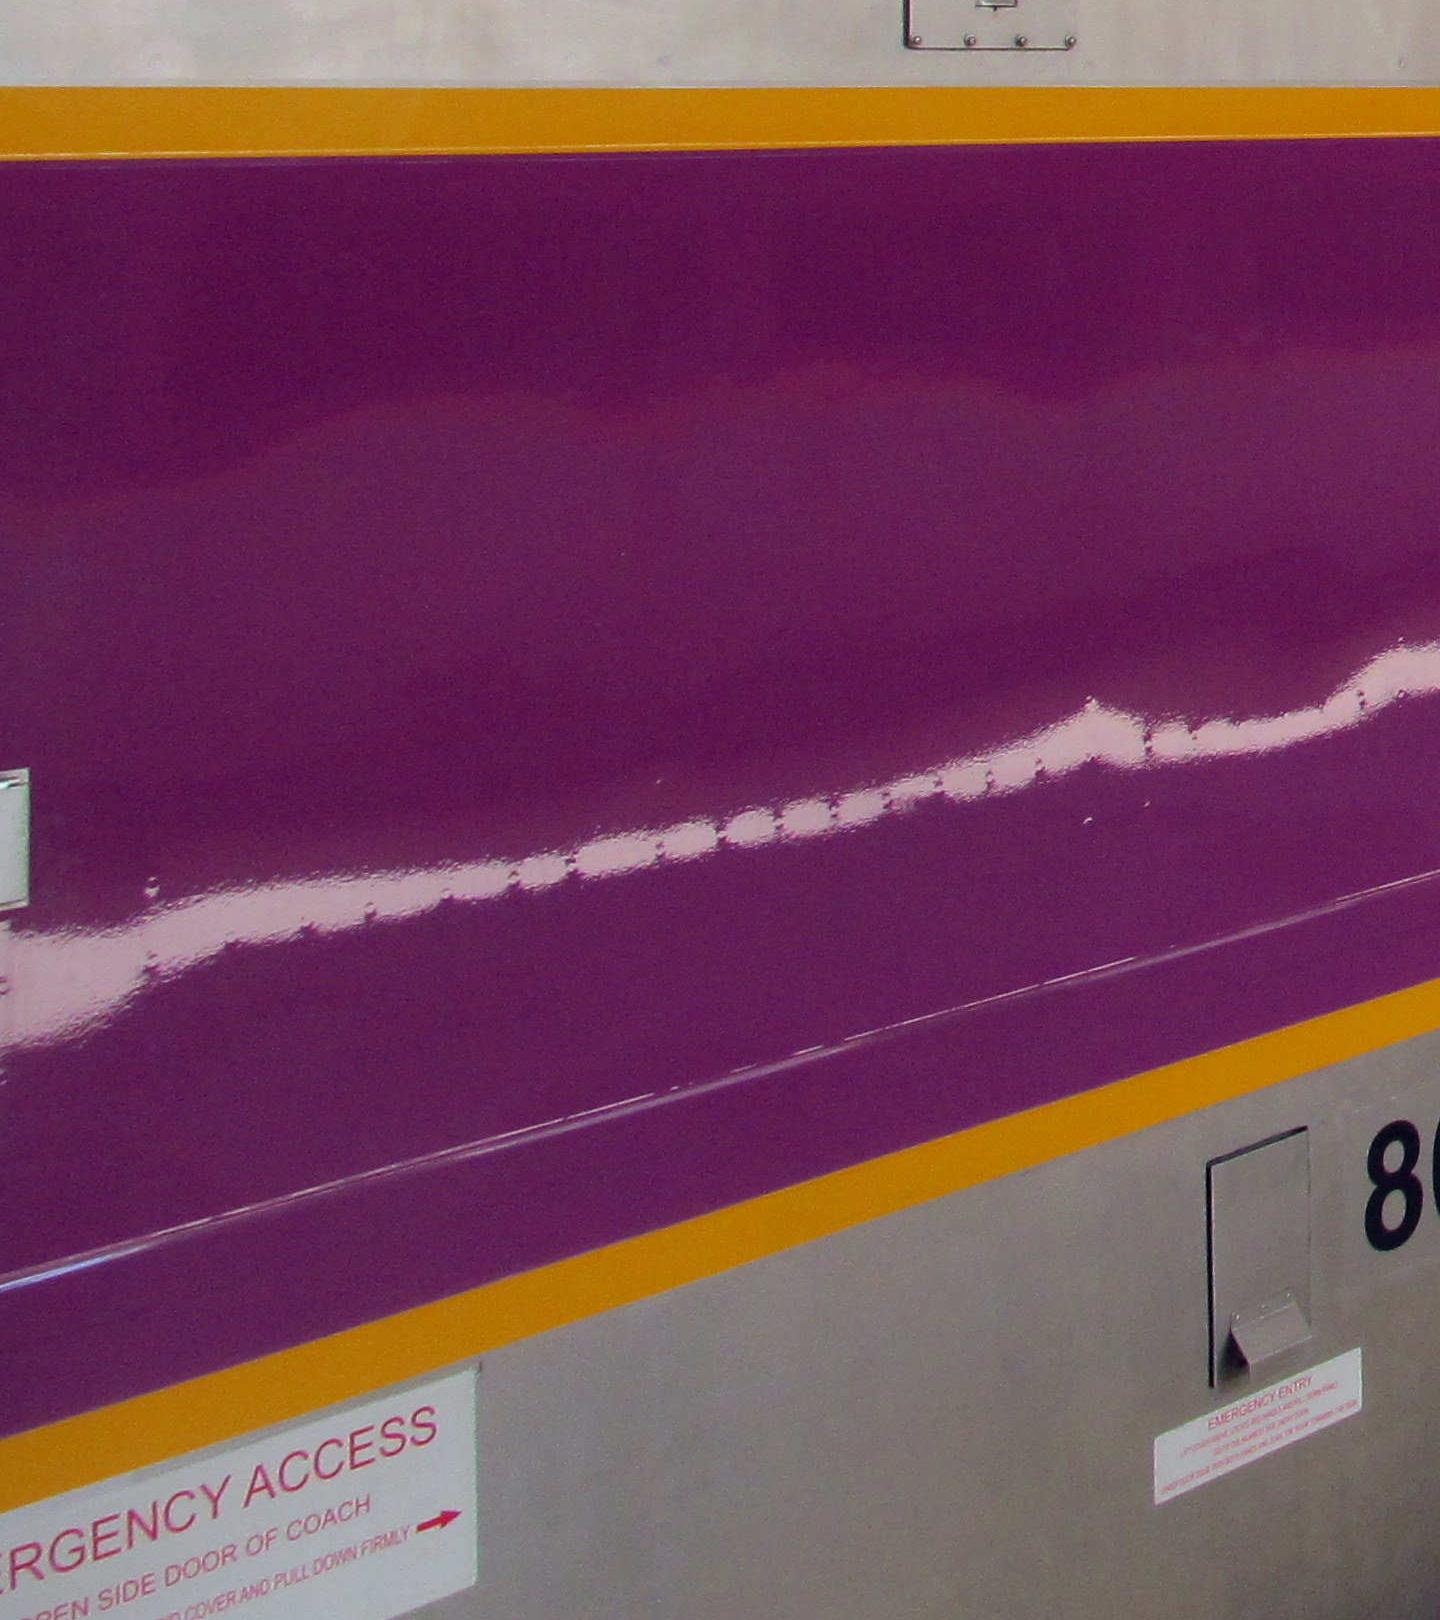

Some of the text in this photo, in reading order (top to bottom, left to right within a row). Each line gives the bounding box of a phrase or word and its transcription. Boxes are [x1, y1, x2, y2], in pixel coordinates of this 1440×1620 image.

[1208, 1390, 1276, 1431] EMERGENCY
[1279, 1373, 1314, 1400] ENTRY
[242, 1405, 438, 1509] ACCESS
[98, 1572, 157, 1611] SIDE
[164, 1543, 238, 1587] DOOR
[245, 1527, 279, 1557] OF
[286, 1493, 371, 1541] COACH
[239, 1578, 271, 1603] AND
[273, 1564, 309, 1590] PULL
[313, 1546, 358, 1576] DOWN
[361, 1524, 411, 1557] FIRMLY
